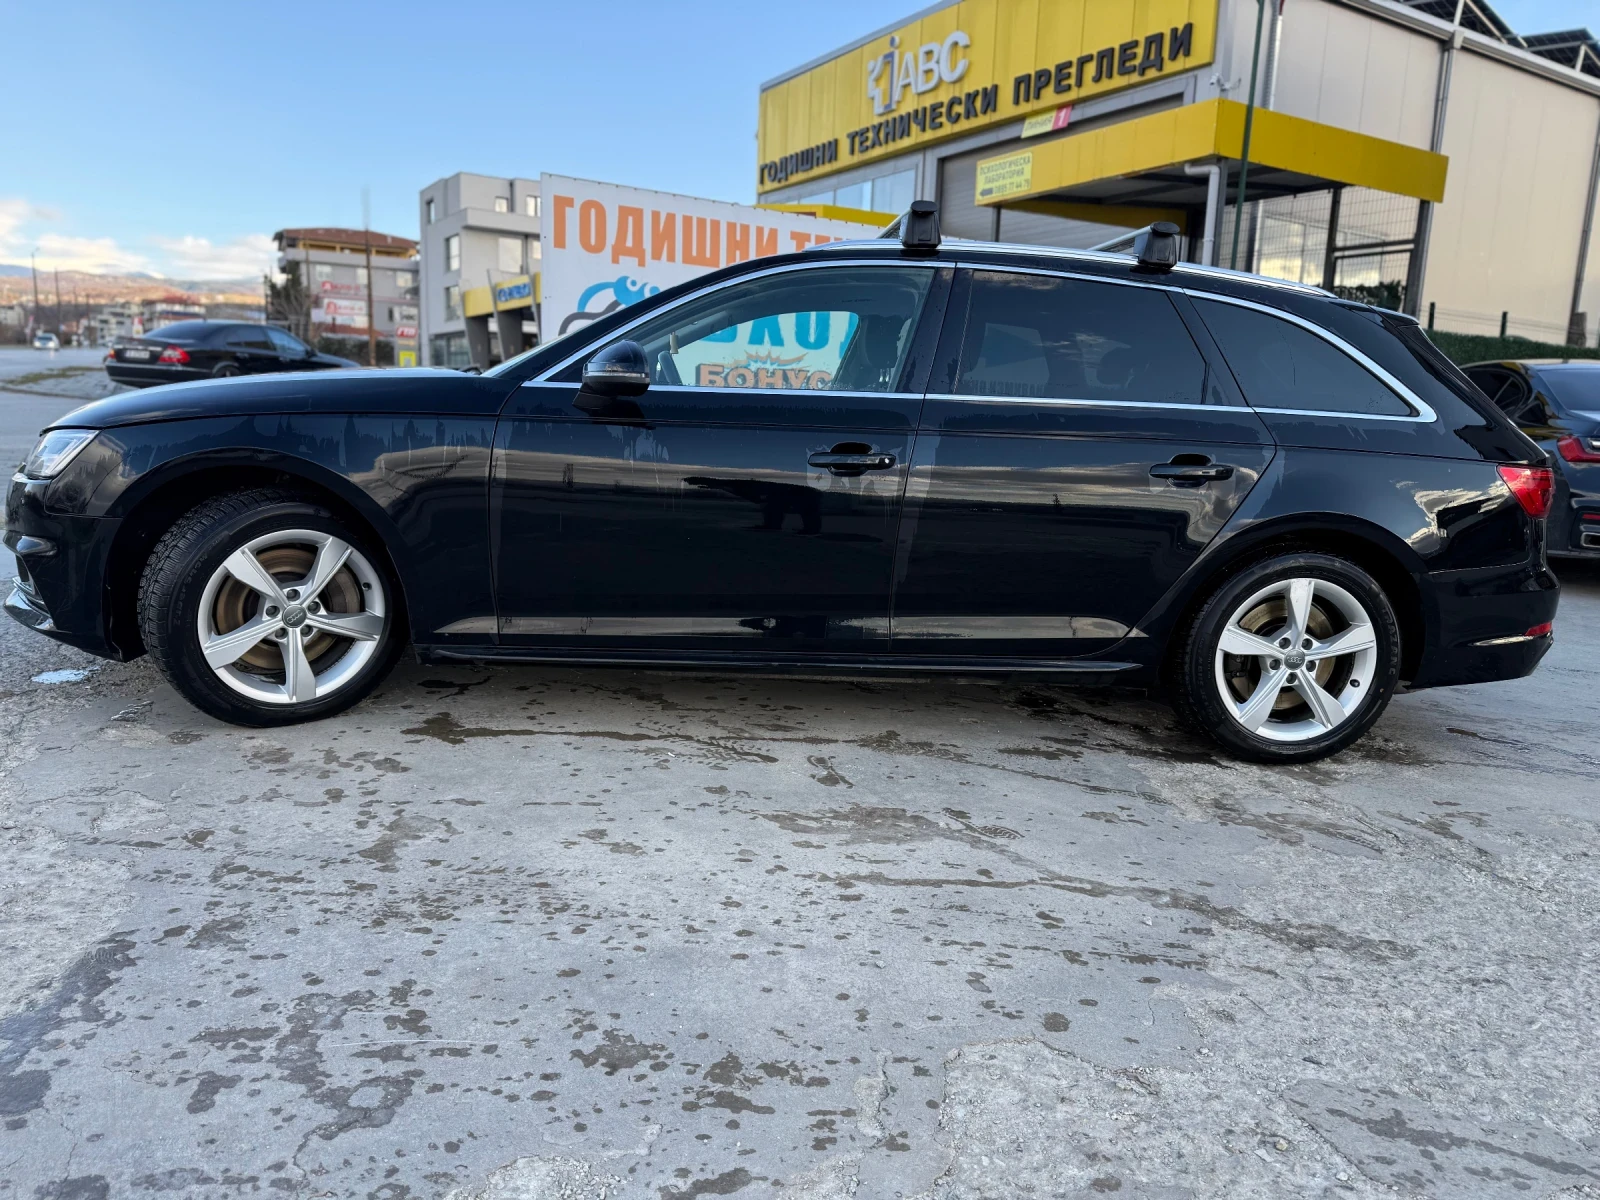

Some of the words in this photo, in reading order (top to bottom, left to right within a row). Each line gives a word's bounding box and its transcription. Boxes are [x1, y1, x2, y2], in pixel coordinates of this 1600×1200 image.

[759, 138, 837, 185] ГОДИШНИ
[847, 84, 998, 156] ТЕХНИЧЕСКИ
[1013, 22, 1193, 105] ПРЕГЛЕДИ
[1058, 108, 1067, 126] 1
[552, 194, 778, 269] ГОДИШНИ
